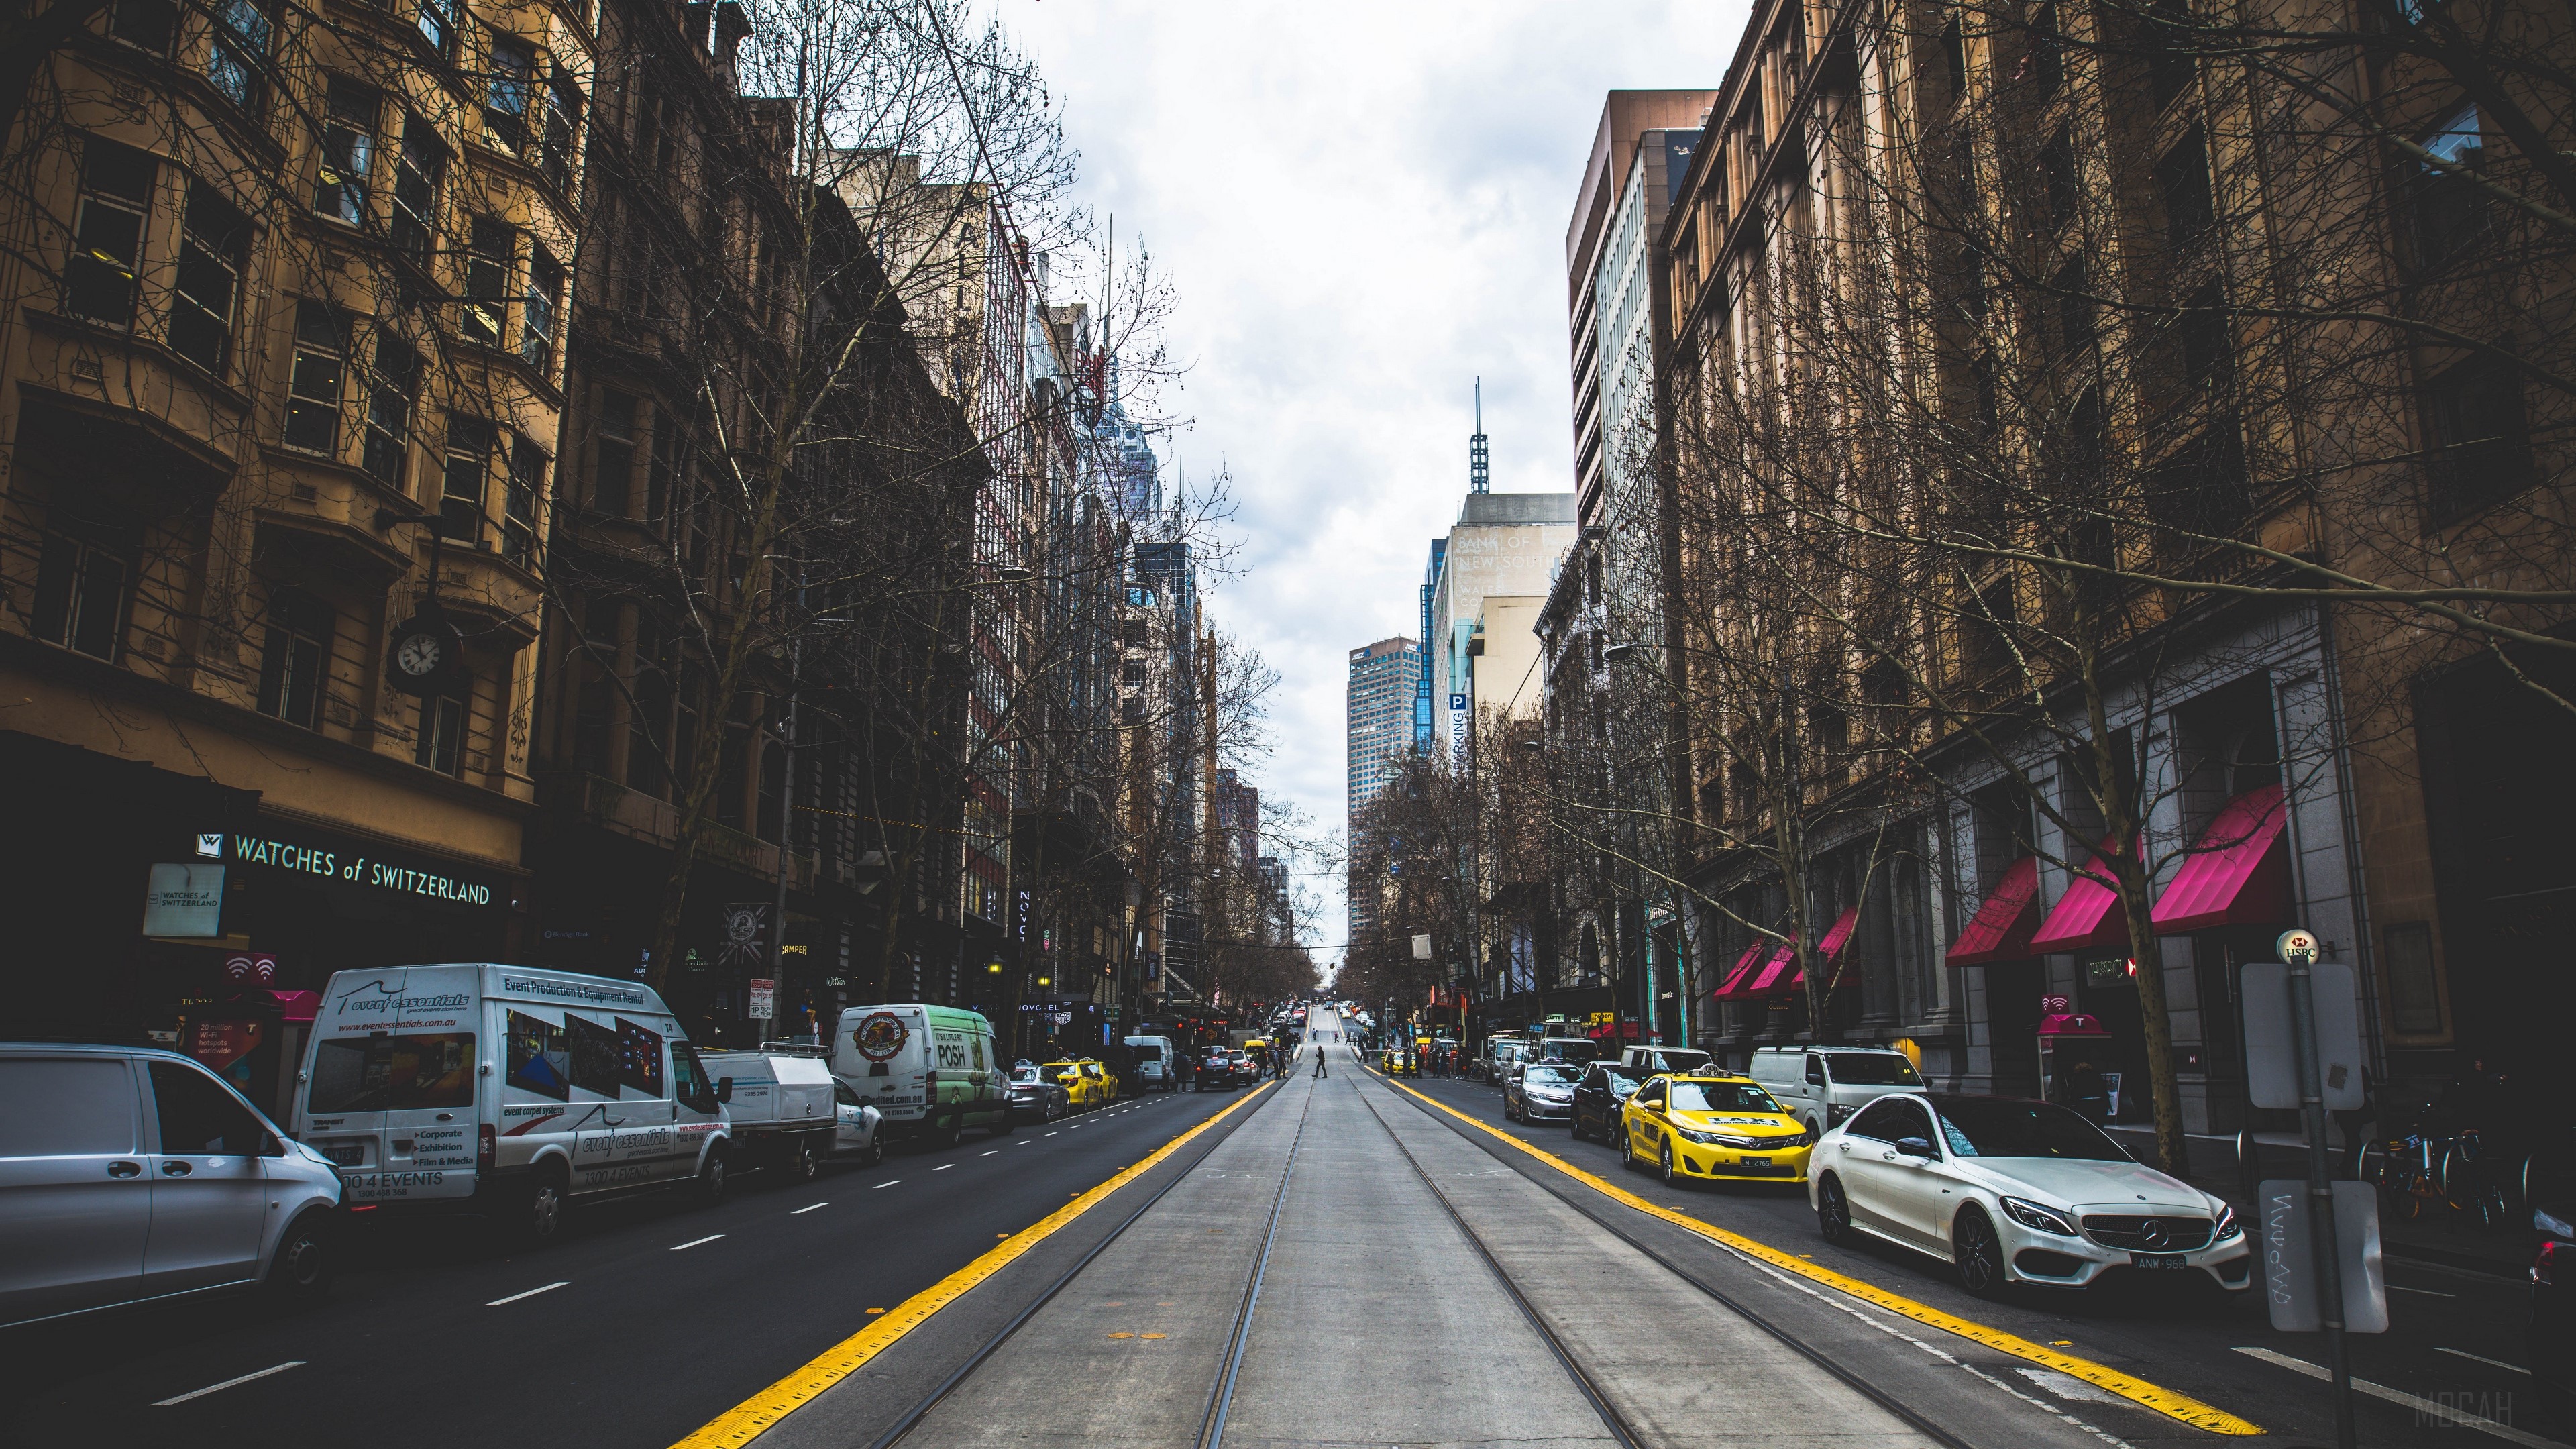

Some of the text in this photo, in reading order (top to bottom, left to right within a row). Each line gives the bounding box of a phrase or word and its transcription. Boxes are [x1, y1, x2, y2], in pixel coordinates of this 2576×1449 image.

[1459, 537, 1530, 548] BANK OF
[1460, 556, 1554, 568] NEW SOUTH
[1405, 643, 1417, 652] ANZ
[1352, 652, 1365, 661] ANZ
[1453, 696, 1463, 708] P
[1453, 713, 1464, 770] PARKING
[235, 834, 490, 905] WATCHES of SWITZERLAND
[2090, 959, 2123, 979] HSBC
[826, 977, 847, 987] Wittner
[504, 978, 644, 1006] Event Production & Equipment Rental
[352, 994, 470, 1012] event essentials
[339, 1019, 457, 1032] www.eventessentials.com.au
[665, 1024, 673, 1033] T4
[937, 1045, 966, 1067] POSH
[504, 1106, 565, 1118] event carpet systems
[678, 1122, 724, 1132] www.eventessentials.com.au
[420, 1130, 462, 1140] Corporate
[583, 1128, 670, 1153] event essentials
[680, 1134, 689, 1142] 1300
[419, 1143, 462, 1152] Exhibition
[419, 1159, 436, 1167] Film
[447, 1157, 474, 1165] Media
[344, 1171, 443, 1189] 00 4 EVENTS
[585, 1165, 650, 1186] 1300 4 EVENTS
[358, 1189, 375, 1197] 1300
[392, 1188, 407, 1197] 368
